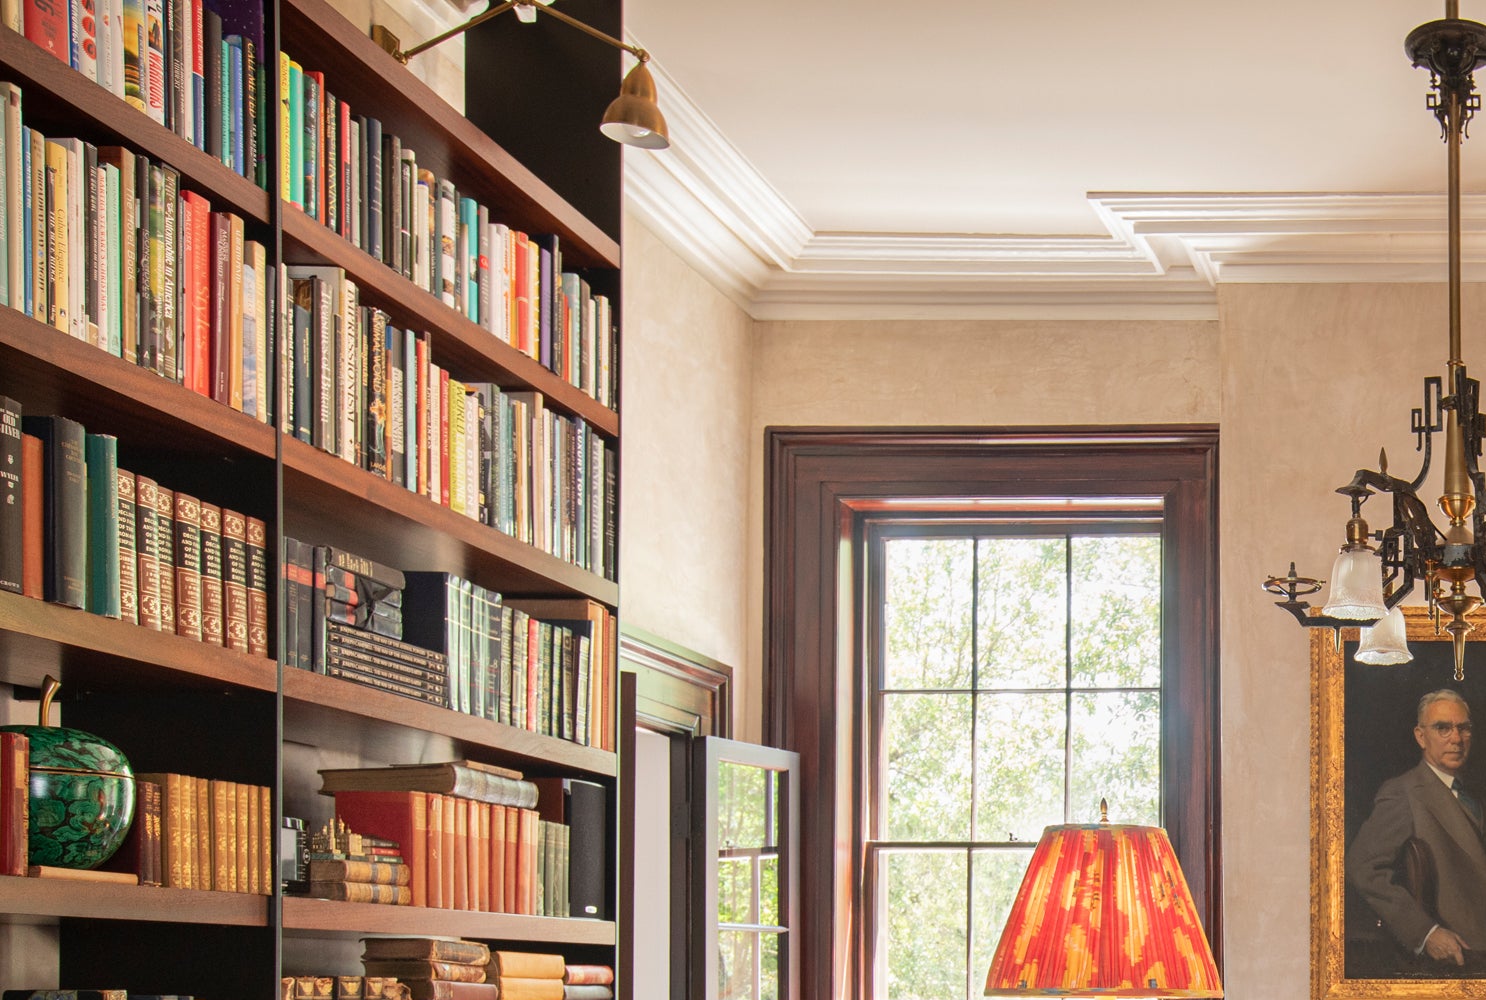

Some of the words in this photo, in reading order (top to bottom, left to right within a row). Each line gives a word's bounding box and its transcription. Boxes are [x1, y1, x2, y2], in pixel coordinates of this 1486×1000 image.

[246, 42, 256, 70] CALL
[149, 52, 163, 109] WARRIORS
[247, 73, 257, 91] ME
[247, 94, 257, 118] TED
[99, 175, 107, 212] MARTHA
[126, 187, 136, 206] The
[328, 152, 337, 216] WINNING
[57, 208, 67, 242] Cuban
[127, 210, 138, 247] Hotel
[165, 212, 175, 265] Automobile
[38, 260, 46, 292] NIGHT
[56, 243, 67, 284] Elegance
[127, 249, 138, 282] Book
[165, 266, 174, 277] in
[100, 263, 108, 312] CHRISTMAS
[165, 277, 175, 319] America
[192, 285, 210, 350] Styles
[320, 290, 331, 353] Treasures
[372, 314, 382, 352] ANIMAL
[321, 354, 331, 371] of
[347, 289, 355, 423] IMPRESSIONISM
[373, 354, 382, 394] WORLD
[321, 374, 332, 423] Britain
[466, 401, 474, 441] POOL
[466, 448, 474, 506] DESIGN
[592, 440, 600, 489] FRANK
[592, 493, 600, 542] GEHRY
